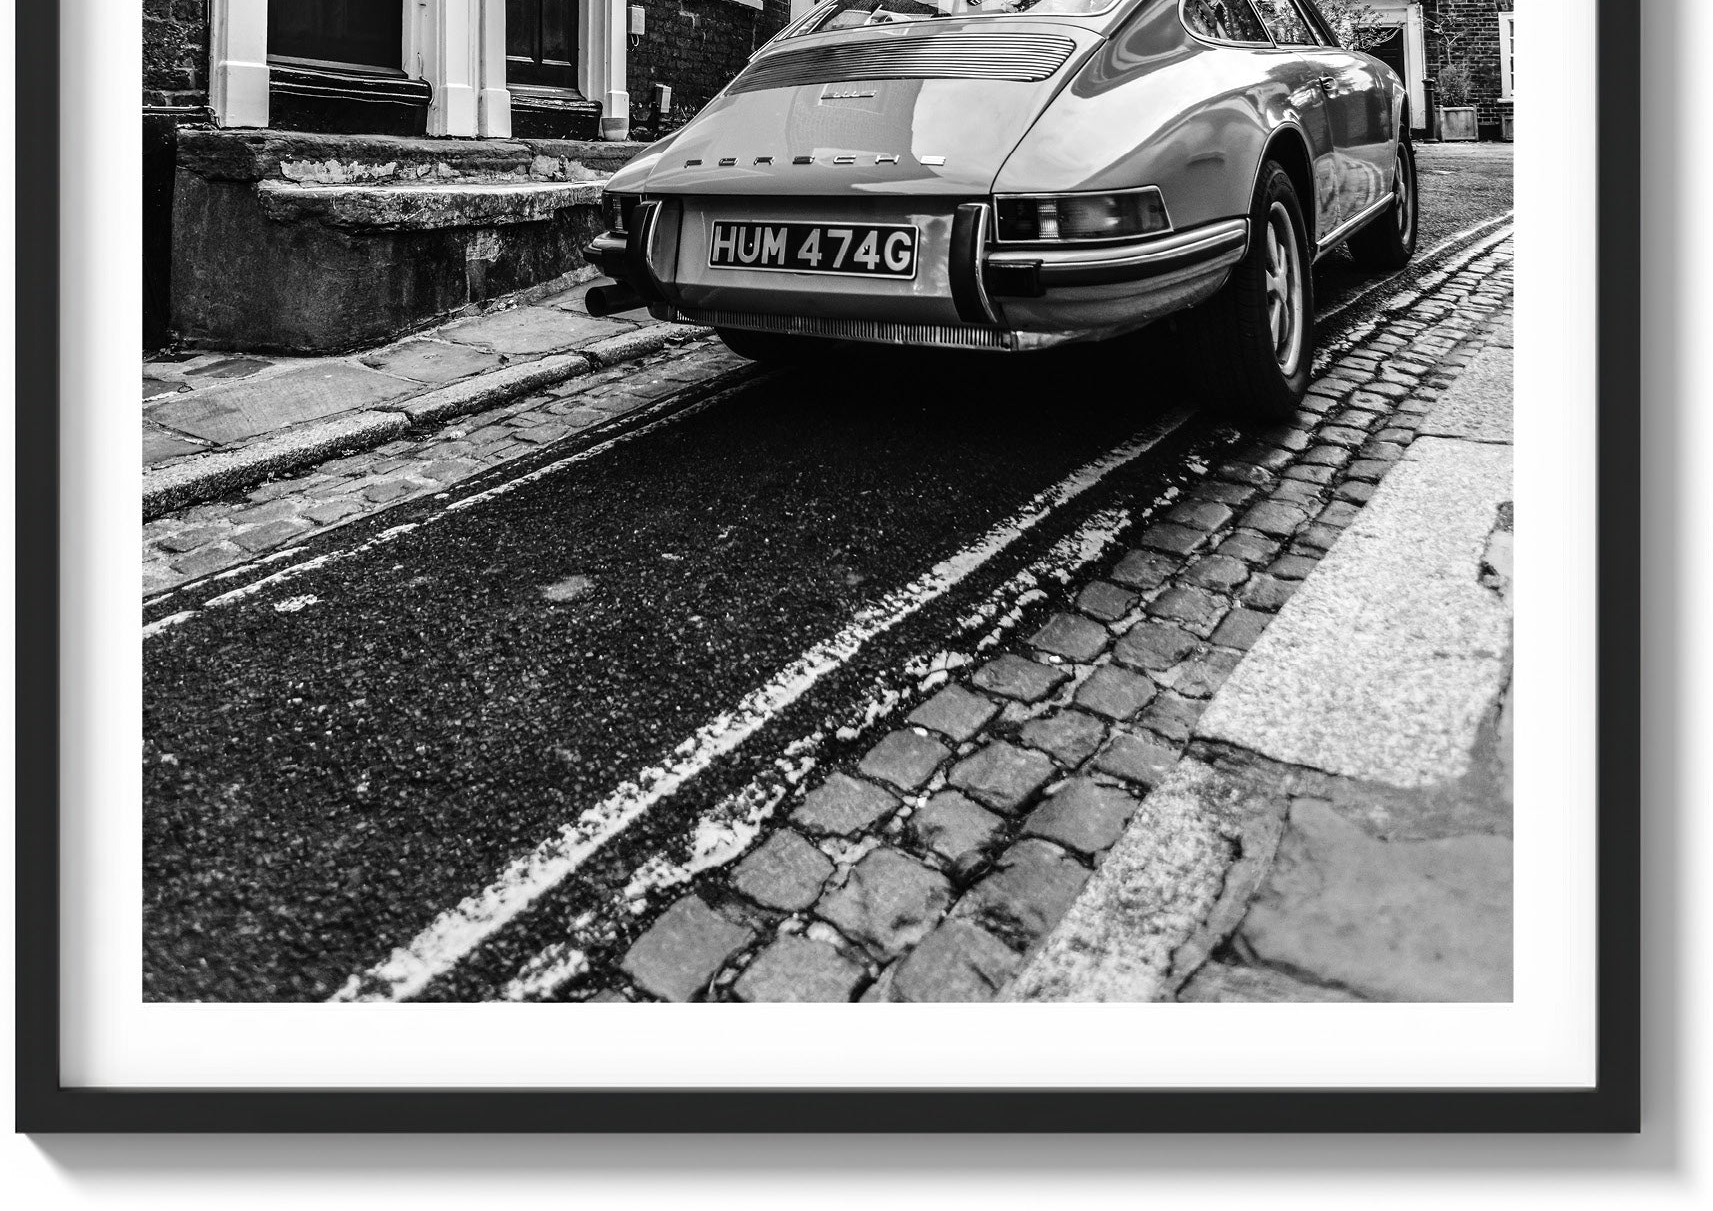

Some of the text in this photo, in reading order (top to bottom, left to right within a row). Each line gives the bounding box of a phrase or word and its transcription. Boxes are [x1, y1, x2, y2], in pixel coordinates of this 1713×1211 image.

[684, 154, 947, 168] PORSCHE
[712, 225, 912, 272] HUM 474G
